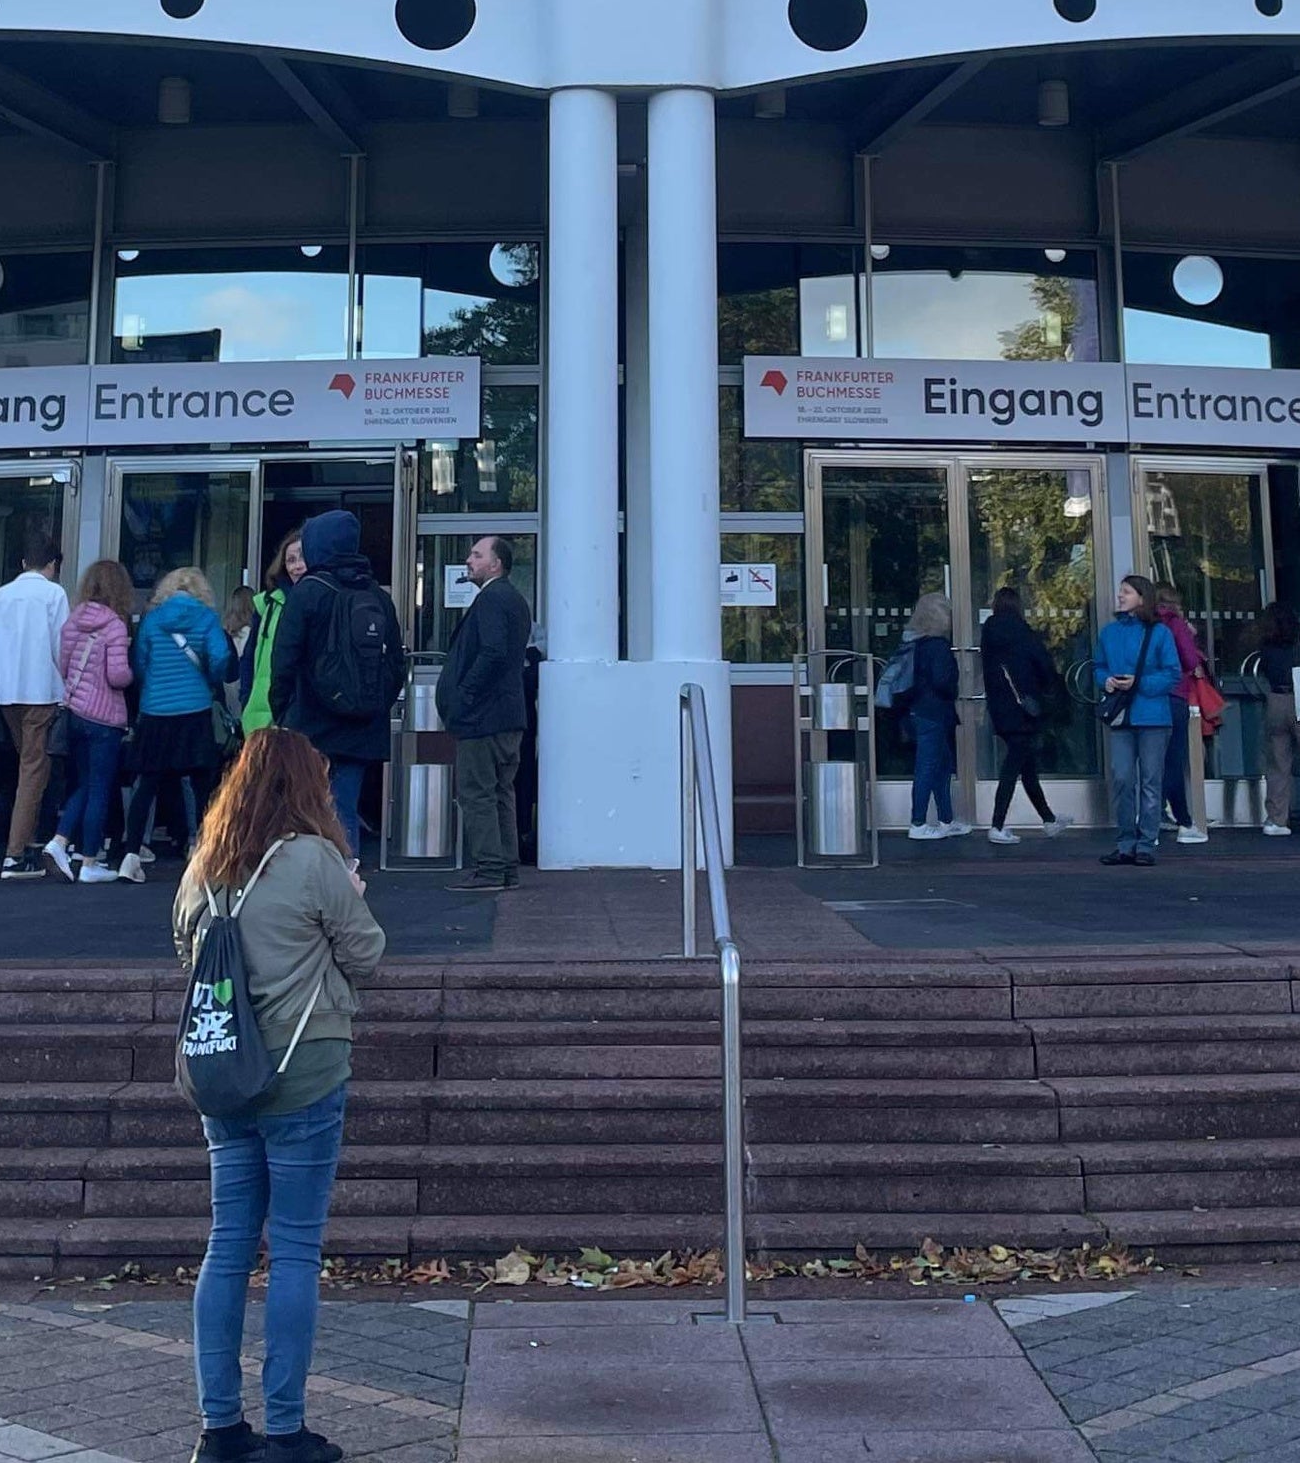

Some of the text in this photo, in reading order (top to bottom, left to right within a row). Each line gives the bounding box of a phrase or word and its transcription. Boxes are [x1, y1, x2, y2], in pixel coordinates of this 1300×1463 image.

[365, 371, 464, 383] FRANKFURTER
[797, 371, 893, 383] FRANKFURTER
[365, 387, 449, 400] BUCHMESSE
[797, 387, 881, 399] BUCHMESSE
[95, 384, 294, 420] Entrance
[924, 378, 1103, 426] Eingang
